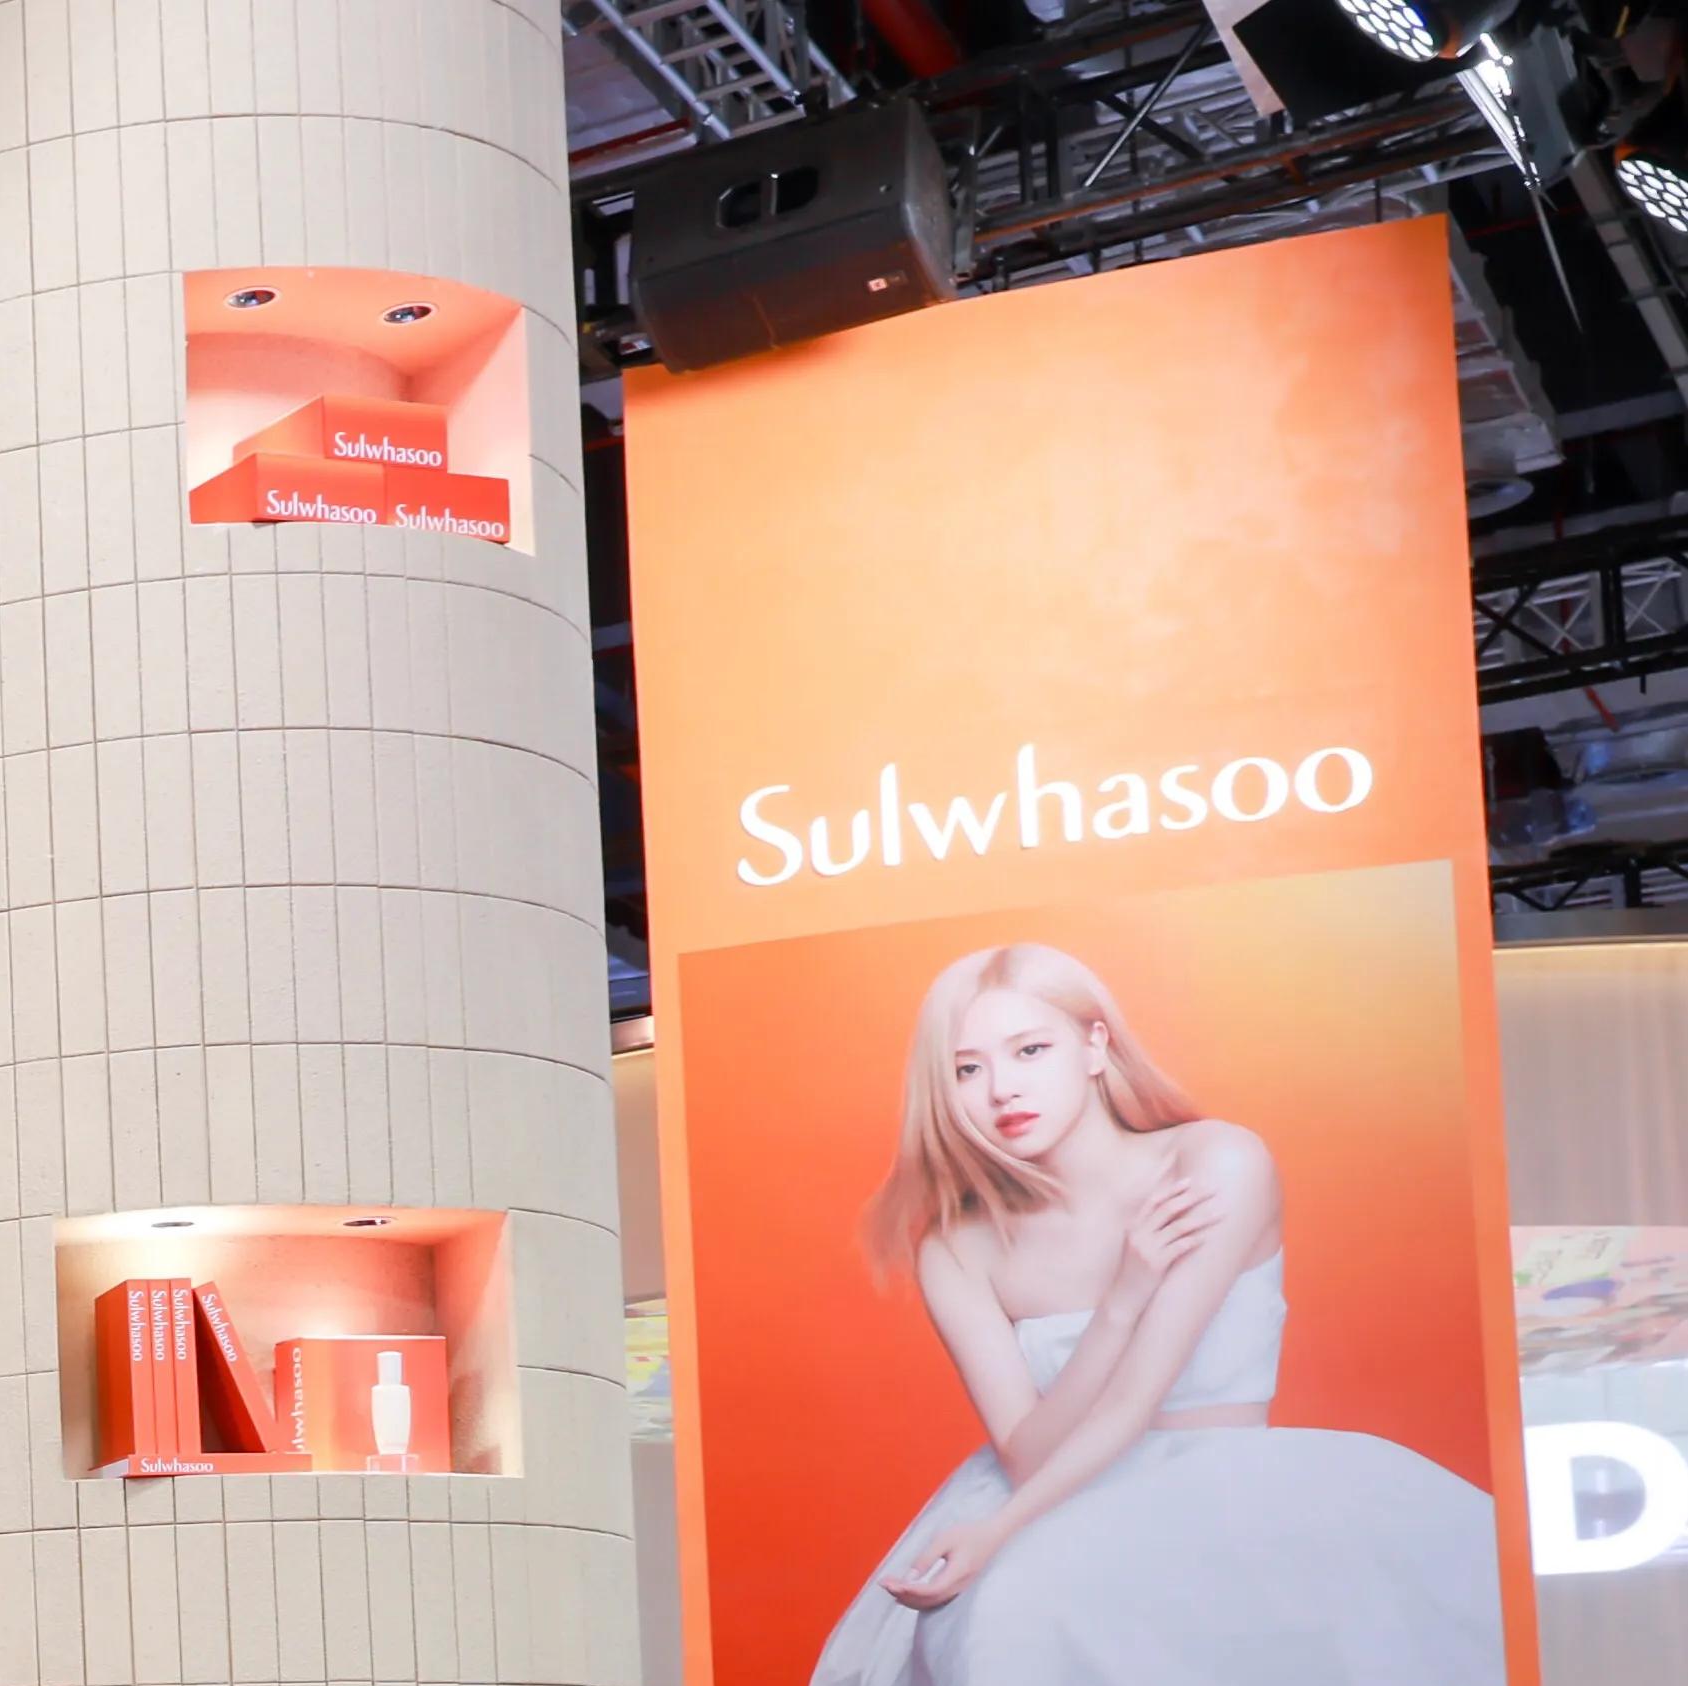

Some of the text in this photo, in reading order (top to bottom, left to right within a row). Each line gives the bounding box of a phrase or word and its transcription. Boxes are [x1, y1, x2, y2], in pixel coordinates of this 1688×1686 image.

[334, 432, 442, 467] Sulwhasoo
[266, 489, 504, 538] Sulwhasoo Sulwhasoo
[737, 743, 1373, 886] Sulwhasoo
[128, 1290, 147, 1362] Sulwhasoo
[152, 1289, 169, 1361] Sulwhasoo
[174, 1288, 191, 1360] Sulwhasoo
[202, 1292, 239, 1362] Sulwhasoo
[140, 1457, 214, 1473] Sulwhasoo
